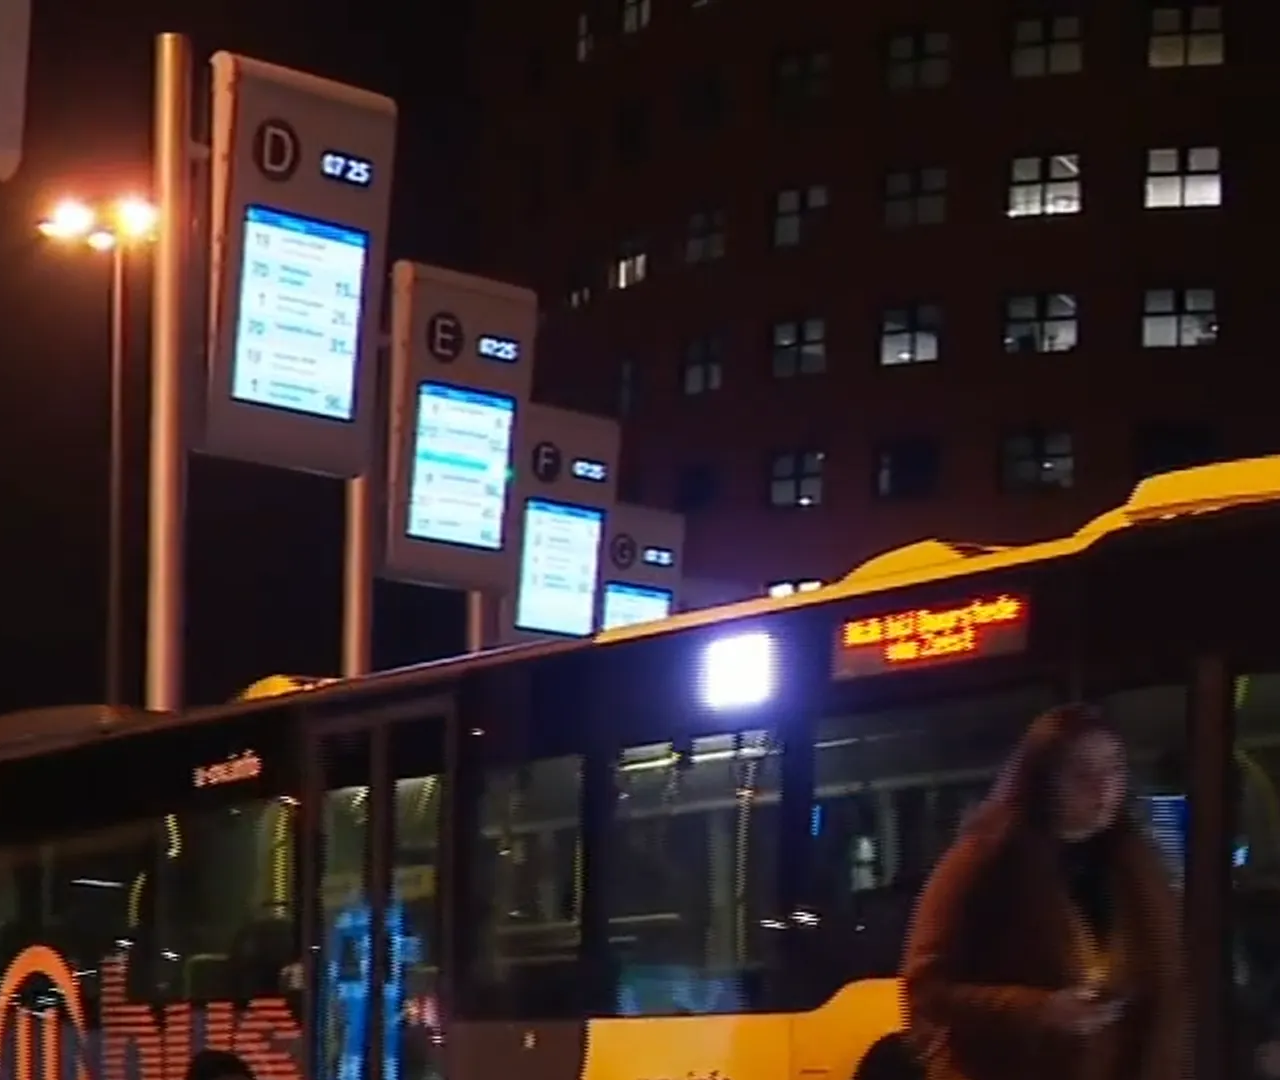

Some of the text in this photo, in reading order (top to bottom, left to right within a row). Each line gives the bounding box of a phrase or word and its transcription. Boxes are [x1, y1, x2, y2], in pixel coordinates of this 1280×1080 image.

[263, 125, 293, 172] D
[433, 317, 456, 356] E
[538, 446, 554, 475] F
